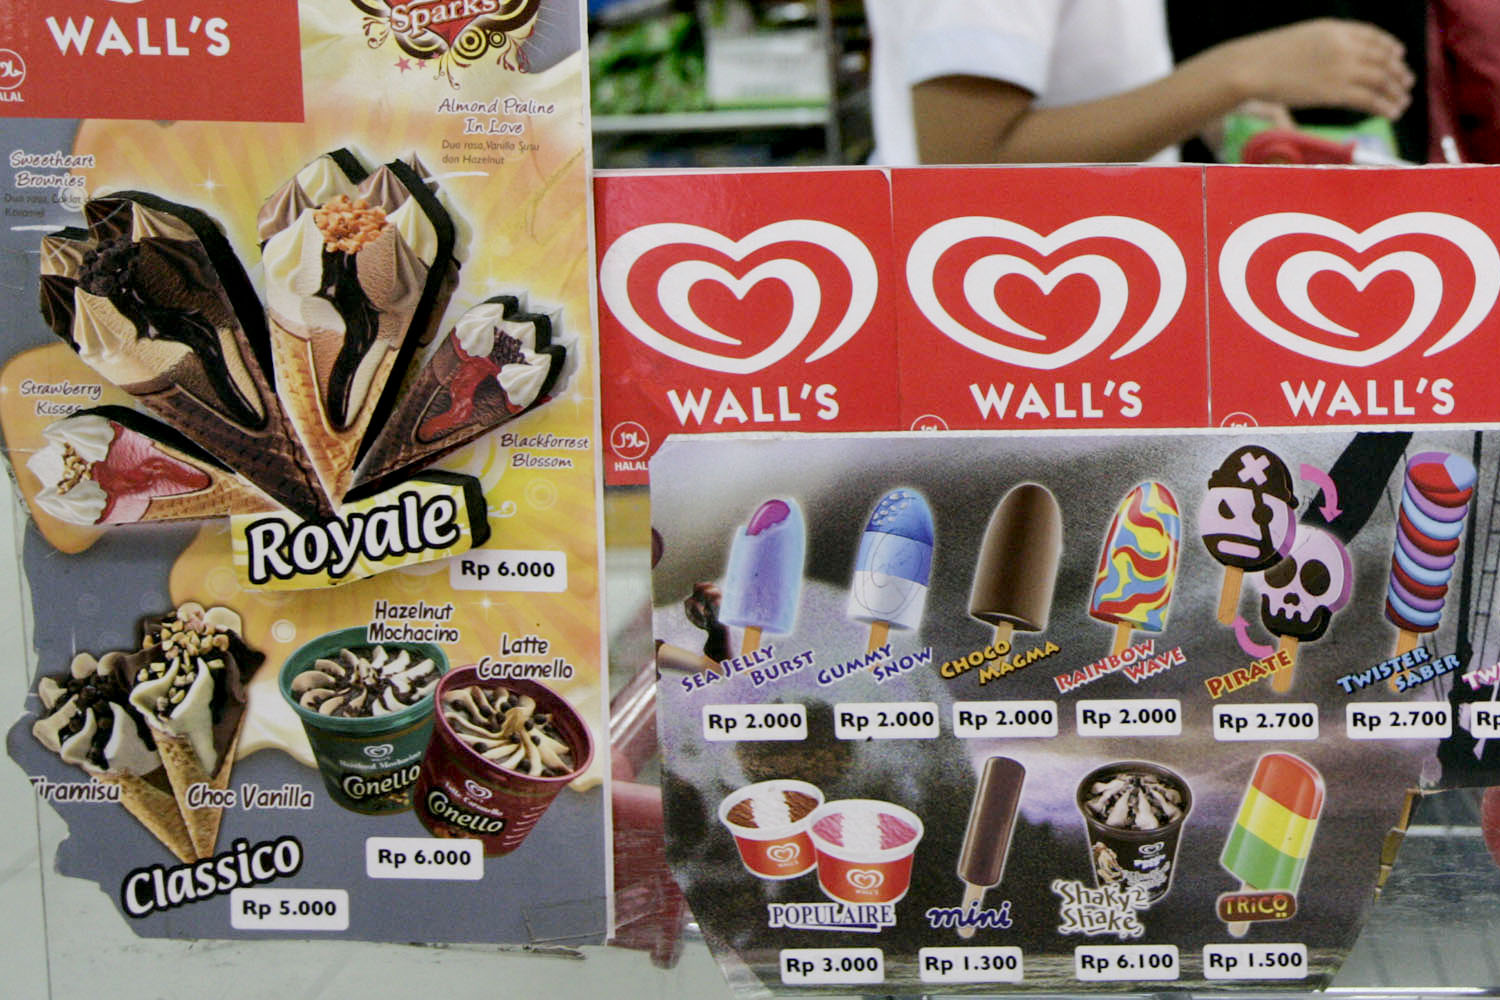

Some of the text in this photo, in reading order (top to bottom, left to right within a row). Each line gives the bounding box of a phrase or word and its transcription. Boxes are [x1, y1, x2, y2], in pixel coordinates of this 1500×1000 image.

[46, 15, 231, 57] WALL'S
[438, 97, 556, 116] Almond Praline
[464, 118, 525, 135] In Love
[10, 150, 95, 168] Sweetheart
[15, 171, 87, 188] Brownies
[21, 380, 103, 400] Strawberry
[970, 380, 1143, 420] WALL'S
[1281, 378, 1455, 417] WALL'S
[35, 400, 83, 418] Kisses
[667, 383, 840, 426] WALL'S
[501, 432, 590, 453] Blackforrest
[512, 452, 573, 470] Blossom
[614, 461, 649, 472] HALAL
[248, 493, 459, 584] Royale
[460, 559, 556, 580] Rp 6.000
[374, 601, 454, 622] Hazelnut
[368, 621, 459, 643] Mochacino
[500, 633, 550, 657] Latte
[478, 656, 574, 681] Caramello
[681, 645, 776, 693] SEA JELLY
[750, 650, 816, 688] BURST
[817, 644, 893, 688] GUMMY
[872, 647, 932, 685] SNOW
[978, 640, 1062, 686] MAGMA
[1053, 638, 1154, 694] RAINBOW
[1123, 646, 1187, 684] WAVE
[1337, 646, 1432, 695] TWISTER
[1393, 653, 1461, 692] SABER
[1205, 650, 1292, 699] PIRATE
[708, 712, 801, 733] Rp 2.000
[840, 711, 934, 730] Rp 2.000
[958, 709, 1053, 728] Rp 2.000
[1081, 708, 1177, 727] Rp 2.000
[1219, 711, 1314, 731] Rp 2.700
[1352, 710, 1447, 730] Rp 2.700
[343, 764, 421, 800] Conello
[186, 783, 313, 809] Choc Vanilla
[428, 790, 503, 833] Conello
[377, 848, 471, 868] Rp 6.000
[122, 837, 302, 917] Classico
[242, 899, 337, 920] Rp 5.000
[771, 904, 894, 925] POPULAIRE
[928, 904, 1013, 930] mini
[1063, 907, 1139, 932] Shake
[787, 955, 879, 976] Rp 3.000
[926, 954, 1017, 975] Rp 1.300
[1081, 953, 1174, 973] Rp 6.100
[1209, 951, 1303, 971] Rp 1.500
